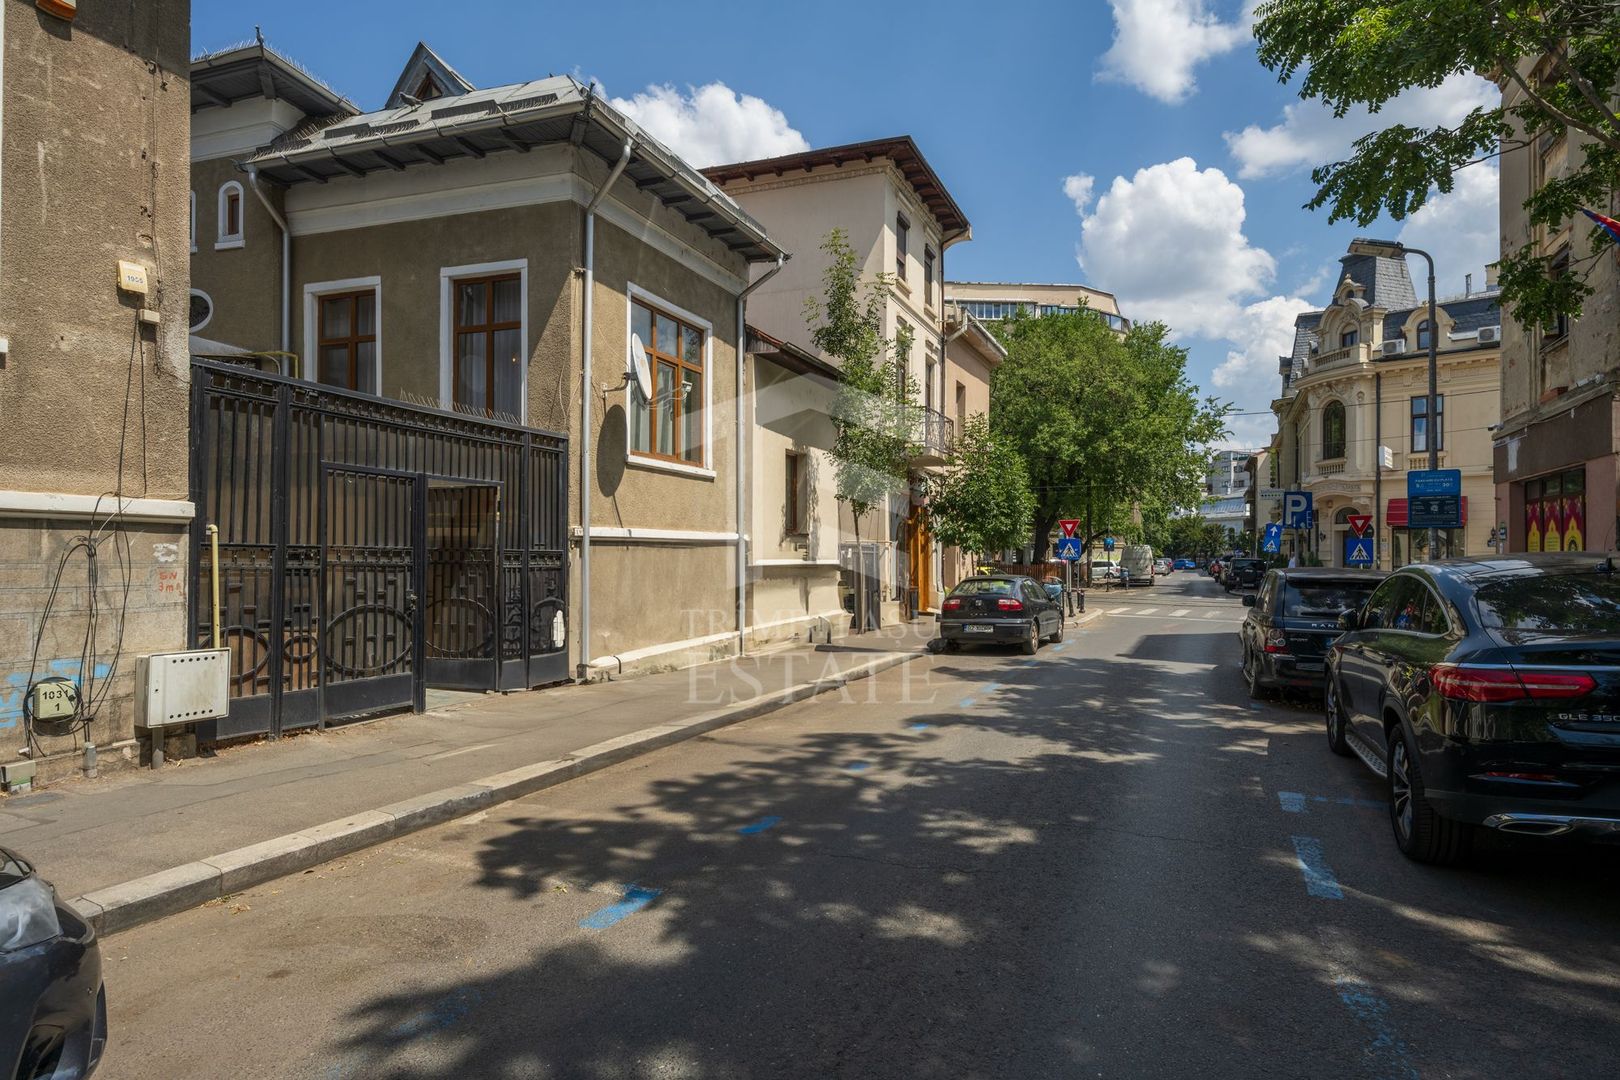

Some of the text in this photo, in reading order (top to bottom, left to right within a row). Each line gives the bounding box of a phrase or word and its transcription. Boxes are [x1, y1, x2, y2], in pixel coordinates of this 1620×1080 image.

[1285, 495, 1307, 525] P
[54, 702, 60, 711] 1
[1558, 713, 1589, 721] GLE
